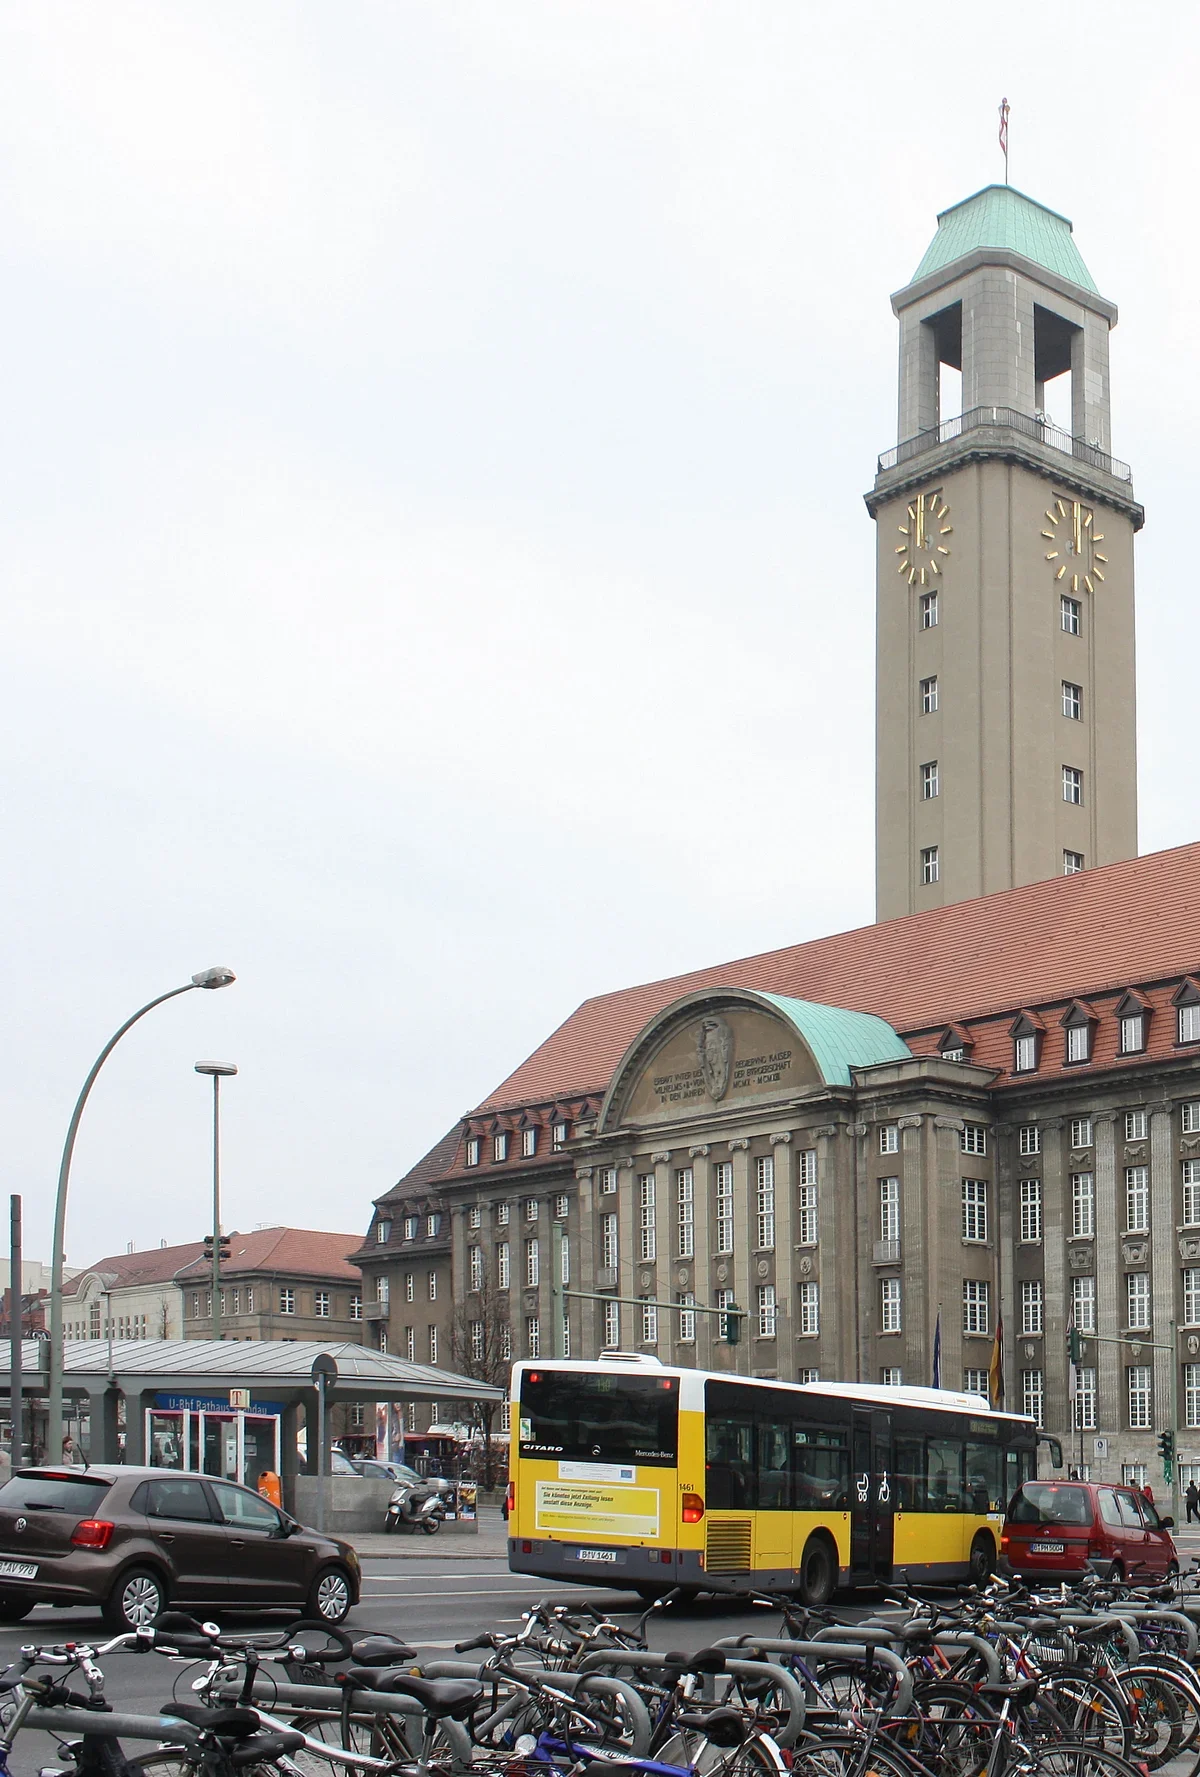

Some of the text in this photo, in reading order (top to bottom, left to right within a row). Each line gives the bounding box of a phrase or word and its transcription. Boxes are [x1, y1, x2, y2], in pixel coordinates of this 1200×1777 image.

[768, 1051, 792, 1062] KAISER
[734, 1070, 745, 1079] DER
[232, 1391, 241, 1405] T
[169, 1398, 194, 1410] U-Bhf
[196, 1400, 230, 1412] Rathaus
[523, 1444, 564, 1452] CITARO
[635, 1450, 674, 1459] Mercedes-Benz
[679, 1483, 694, 1491] 1461
